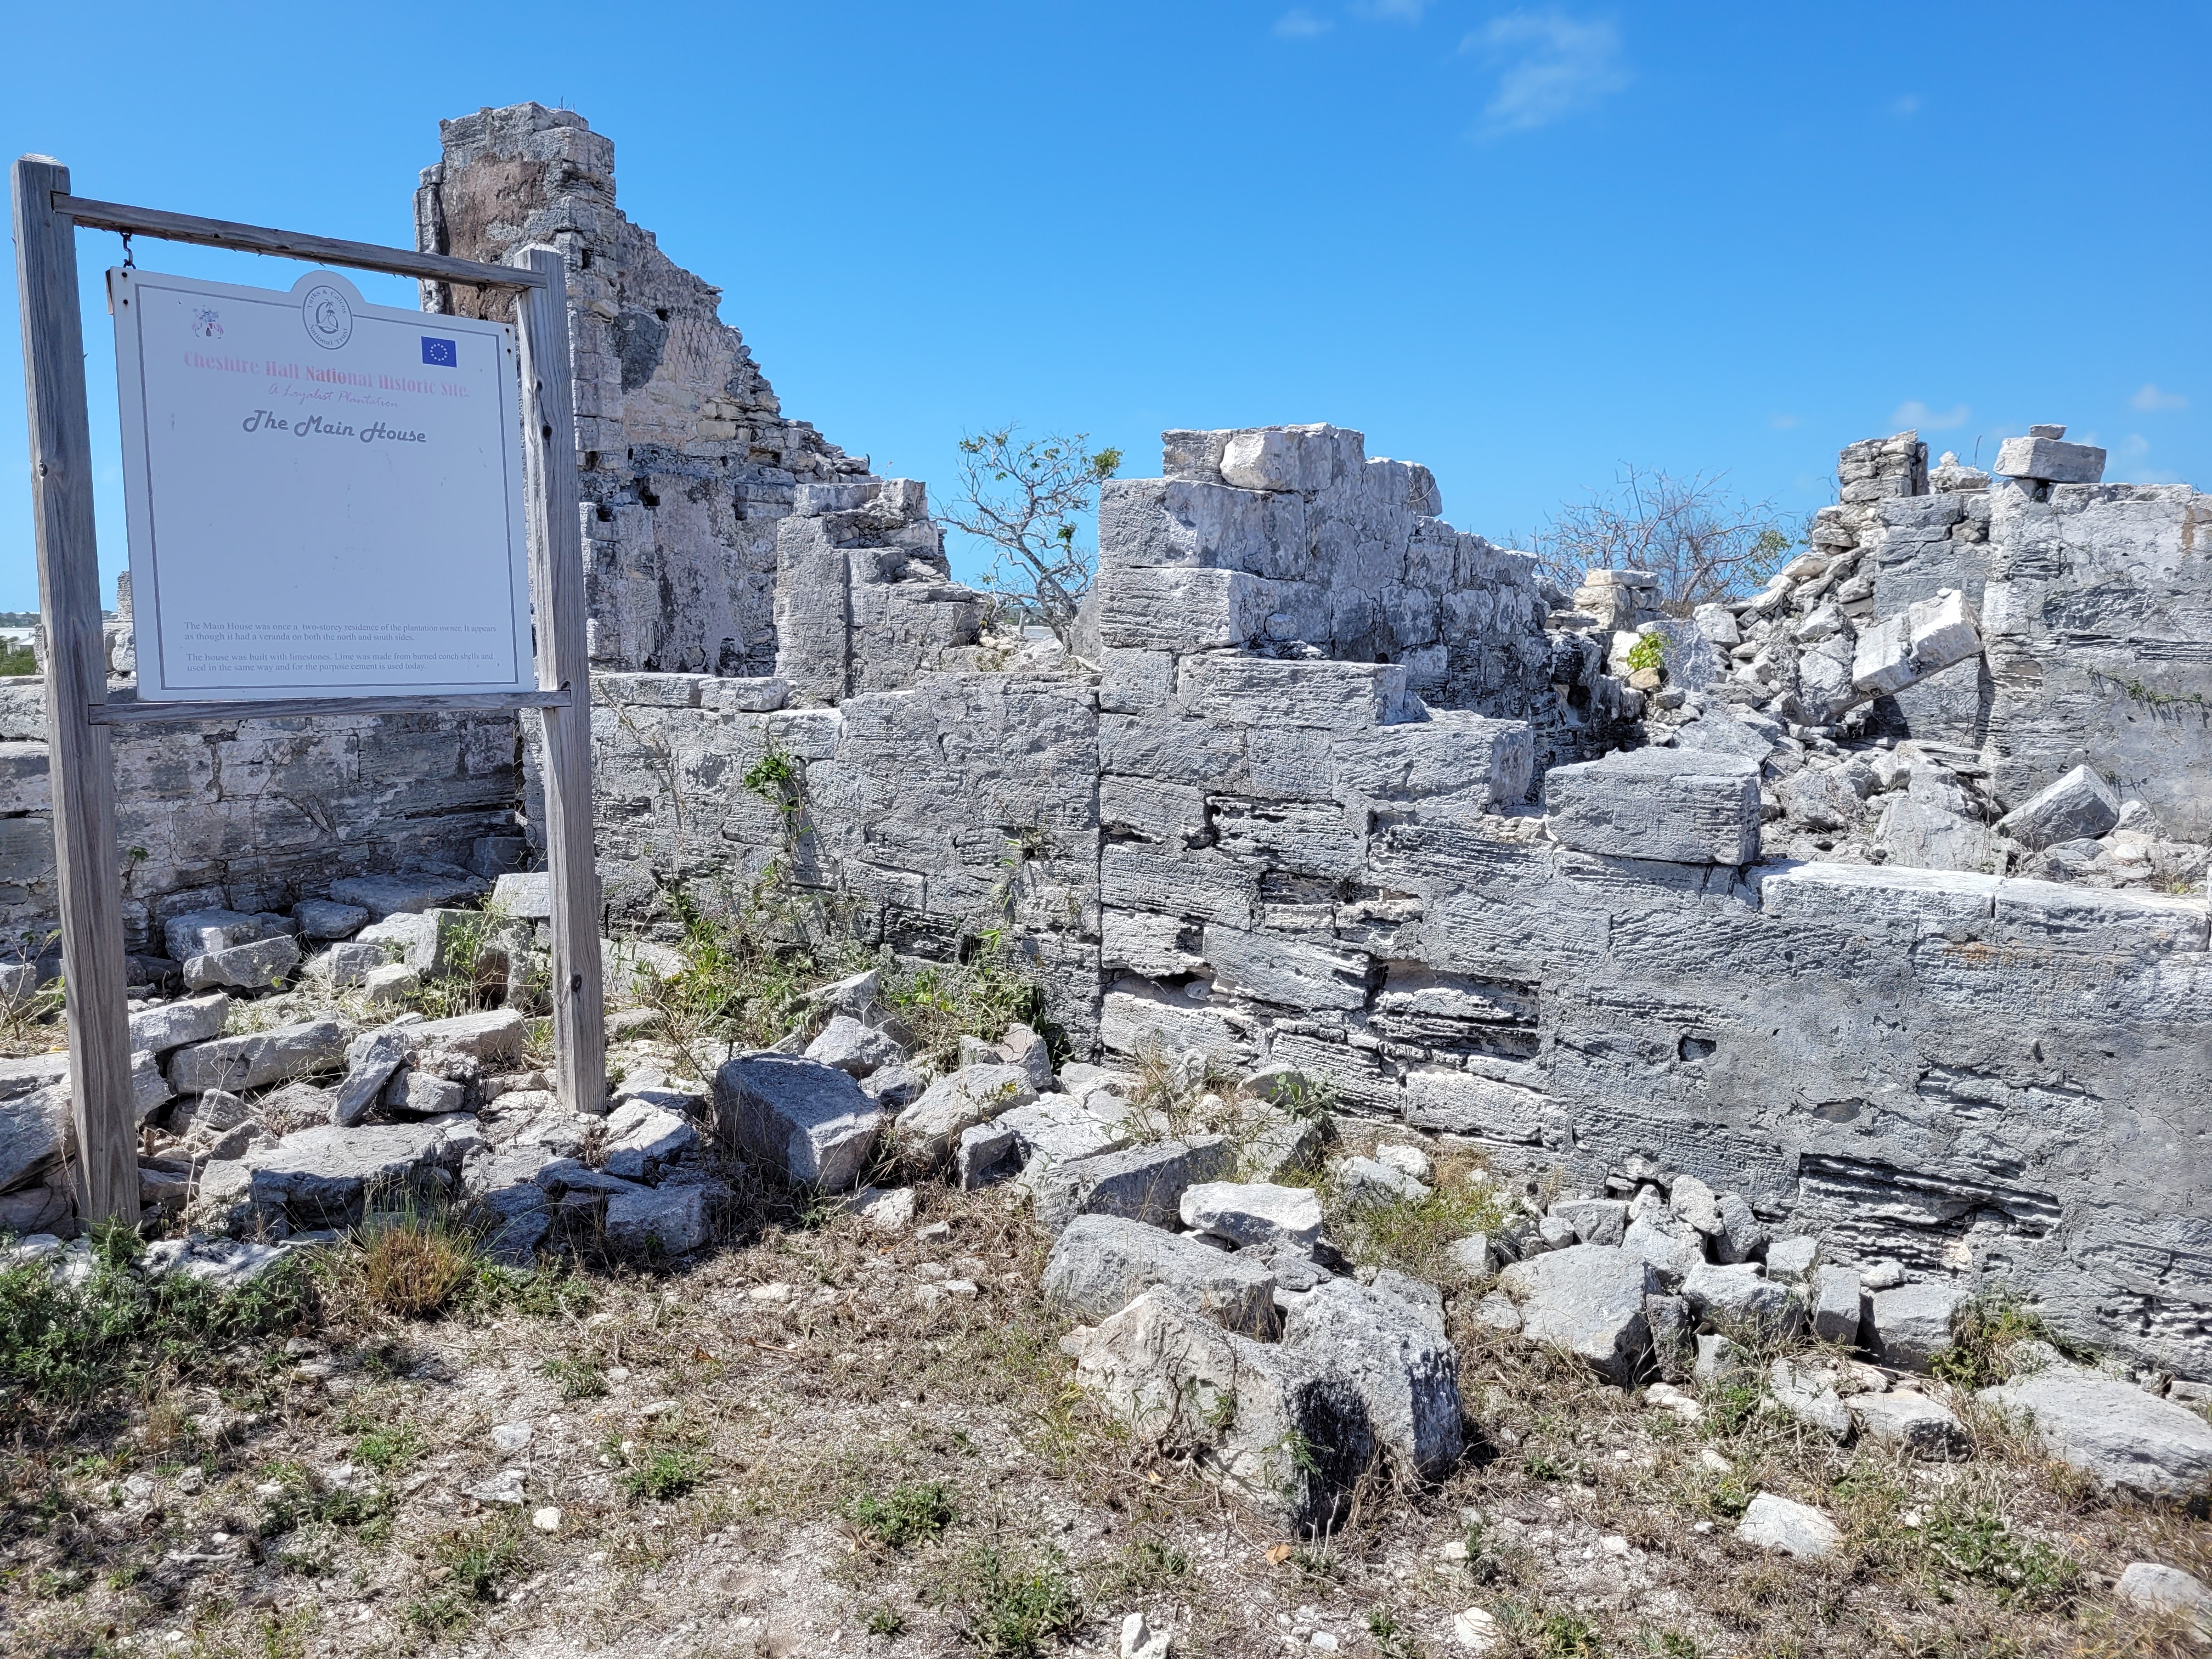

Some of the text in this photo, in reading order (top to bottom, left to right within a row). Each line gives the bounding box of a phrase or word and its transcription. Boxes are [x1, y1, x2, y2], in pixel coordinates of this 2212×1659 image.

[307, 291, 320, 309] Turks
[308, 324, 348, 345] National Trust
[183, 351, 259, 374] Cheshire
[265, 360, 299, 379] Hall
[306, 365, 373, 387] National
[379, 375, 436, 394] Historic
[283, 385, 334, 404] Loyalist
[338, 391, 398, 407] Plantation
[242, 410, 426, 443] The Main House
[196, 633, 224, 641] though
[403, 624, 438, 633] plantation
[405, 662, 426, 670] today.
